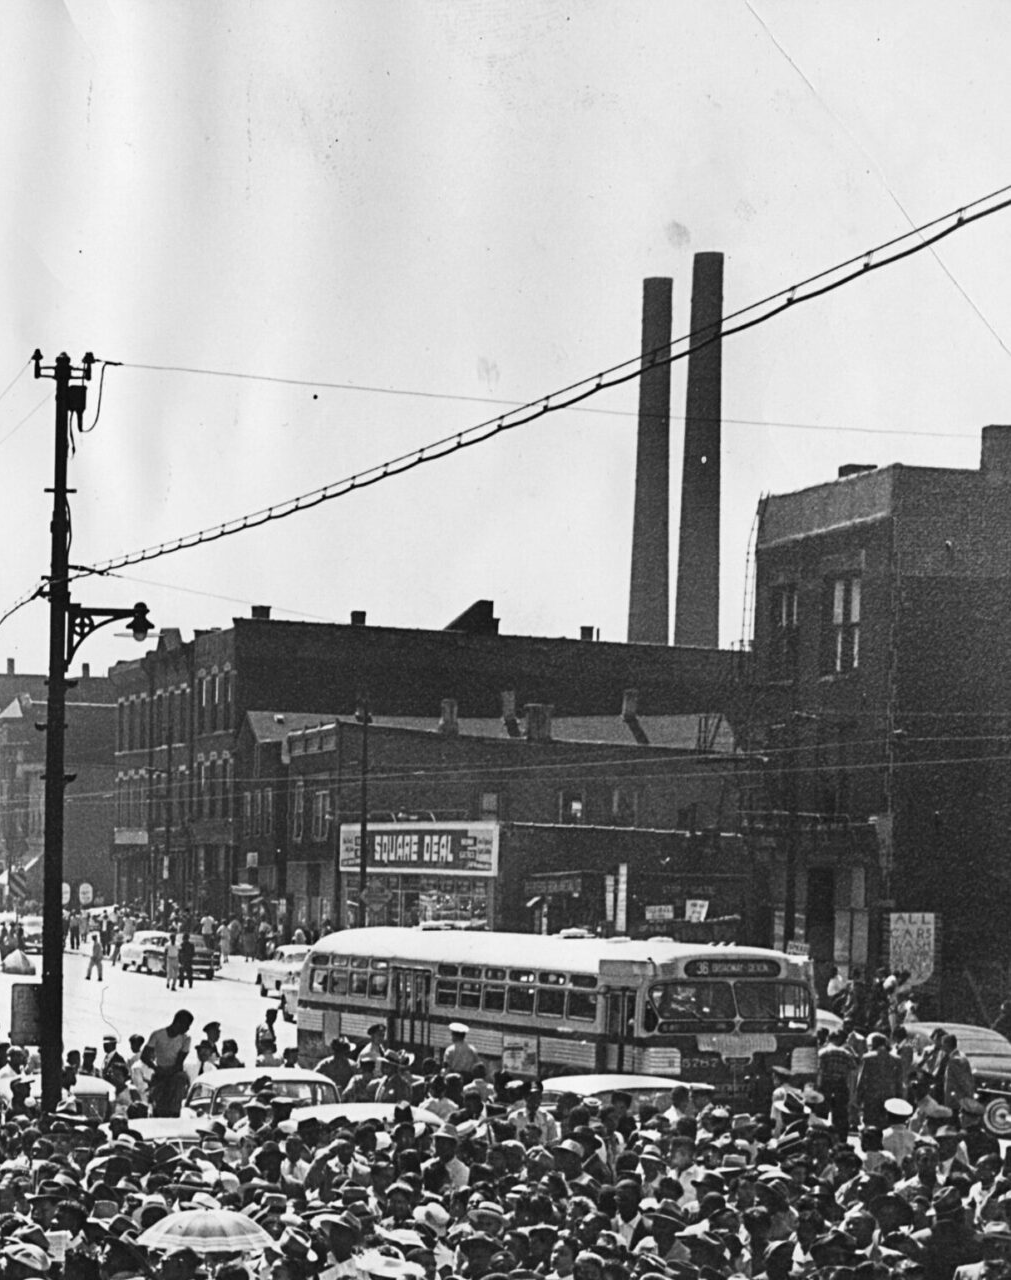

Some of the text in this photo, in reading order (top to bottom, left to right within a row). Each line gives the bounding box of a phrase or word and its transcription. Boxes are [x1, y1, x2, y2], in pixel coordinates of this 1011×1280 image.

[374, 835, 418, 863] SQUARE
[423, 835, 453, 862] DEAL
[894, 914, 931, 925] ALL
[891, 928, 932, 939] CARS
[696, 962, 709, 974] 36
